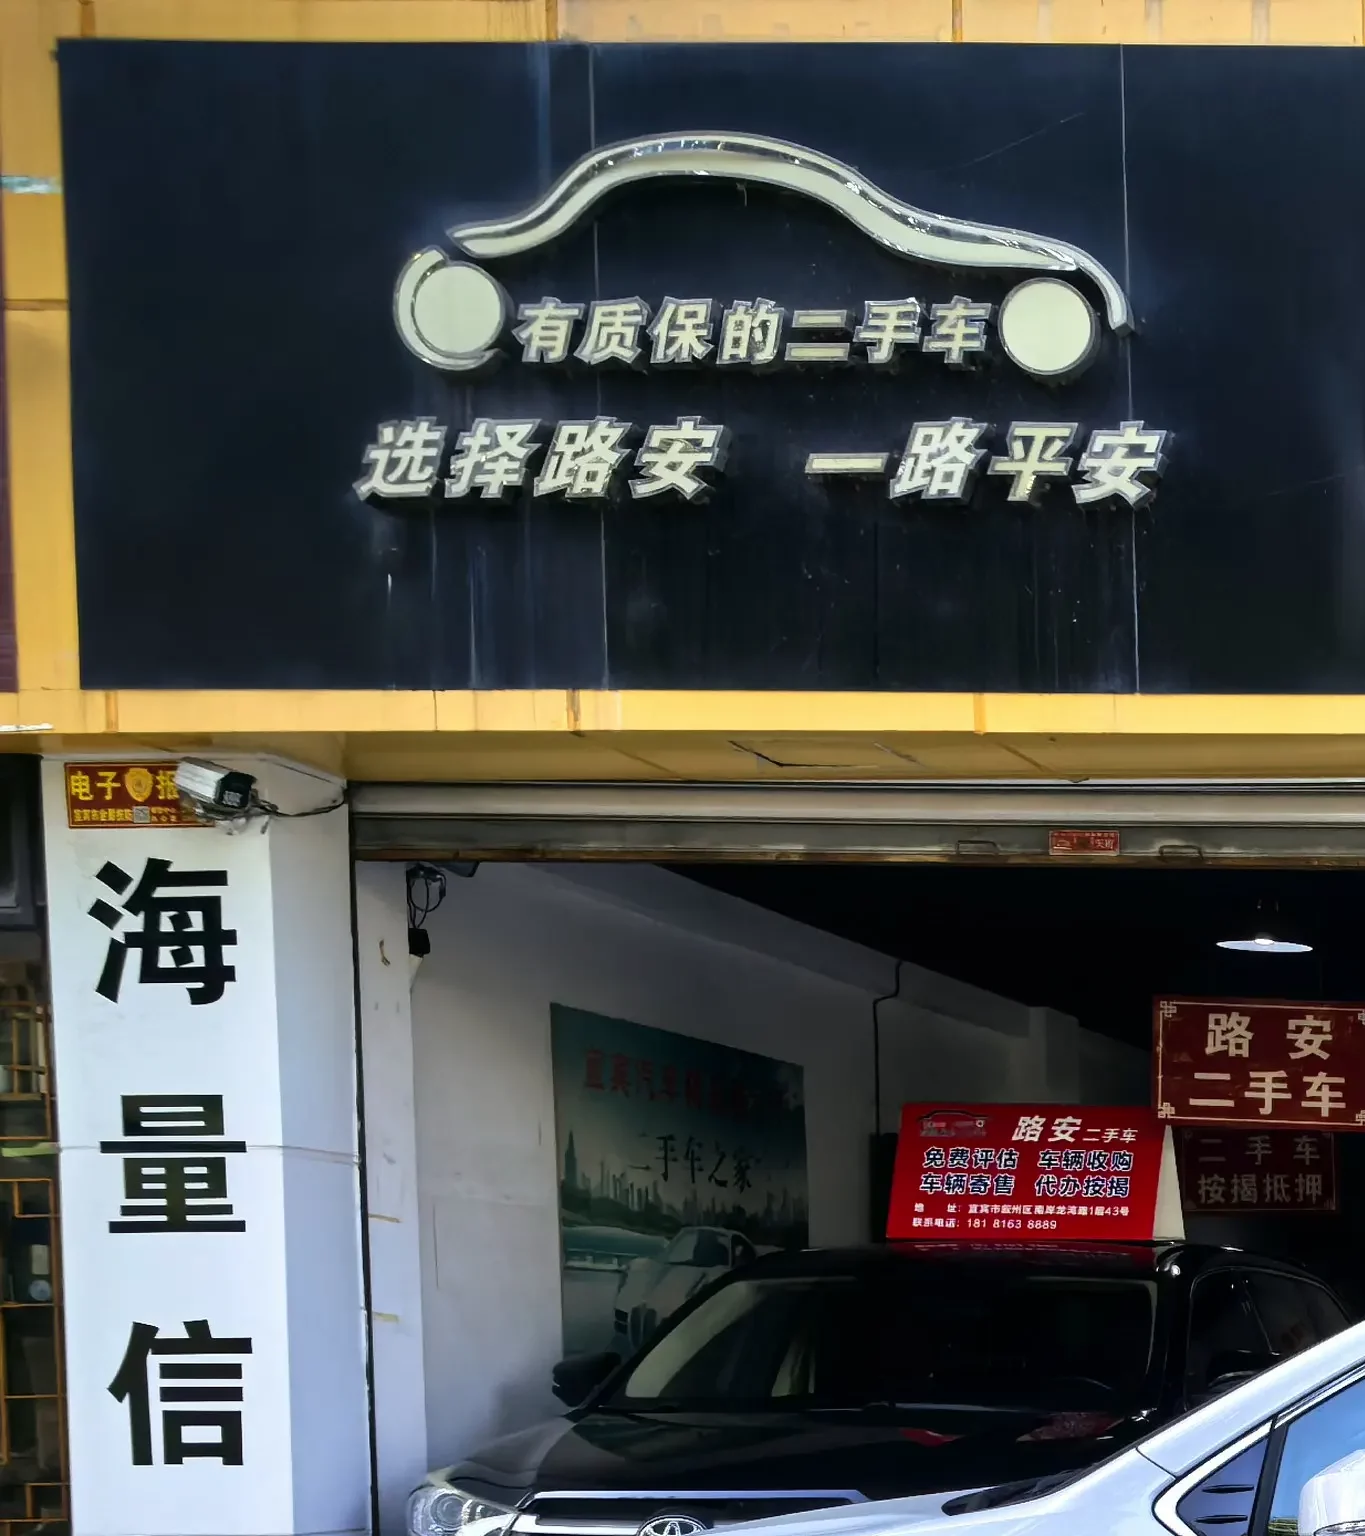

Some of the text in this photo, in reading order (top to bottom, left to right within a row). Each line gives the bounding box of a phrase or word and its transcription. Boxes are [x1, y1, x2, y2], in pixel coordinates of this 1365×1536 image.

[512, 296, 996, 366] 有质保的二手车
[352, 415, 1170, 505] 选择路安 一路平安
[70, 771, 122, 801] 电子
[1204, 1011, 1333, 1061] 路安
[1188, 1069, 1347, 1118] 二手车
[1011, 1115, 1082, 1142] 路安
[1082, 1127, 1139, 1143] 二手车
[923, 1146, 1134, 1172] 免费评估 车辆收购
[1198, 1134, 1321, 1167] 二手车
[918, 1172, 1131, 1198] 车辆寄售 代办按揭
[1197, 1172, 1324, 1205] 按揭抵押
[966, 1218, 987, 1229] 181
[992, 1219, 1022, 1230] 8163
[1026, 1220, 1058, 1231] 8889
